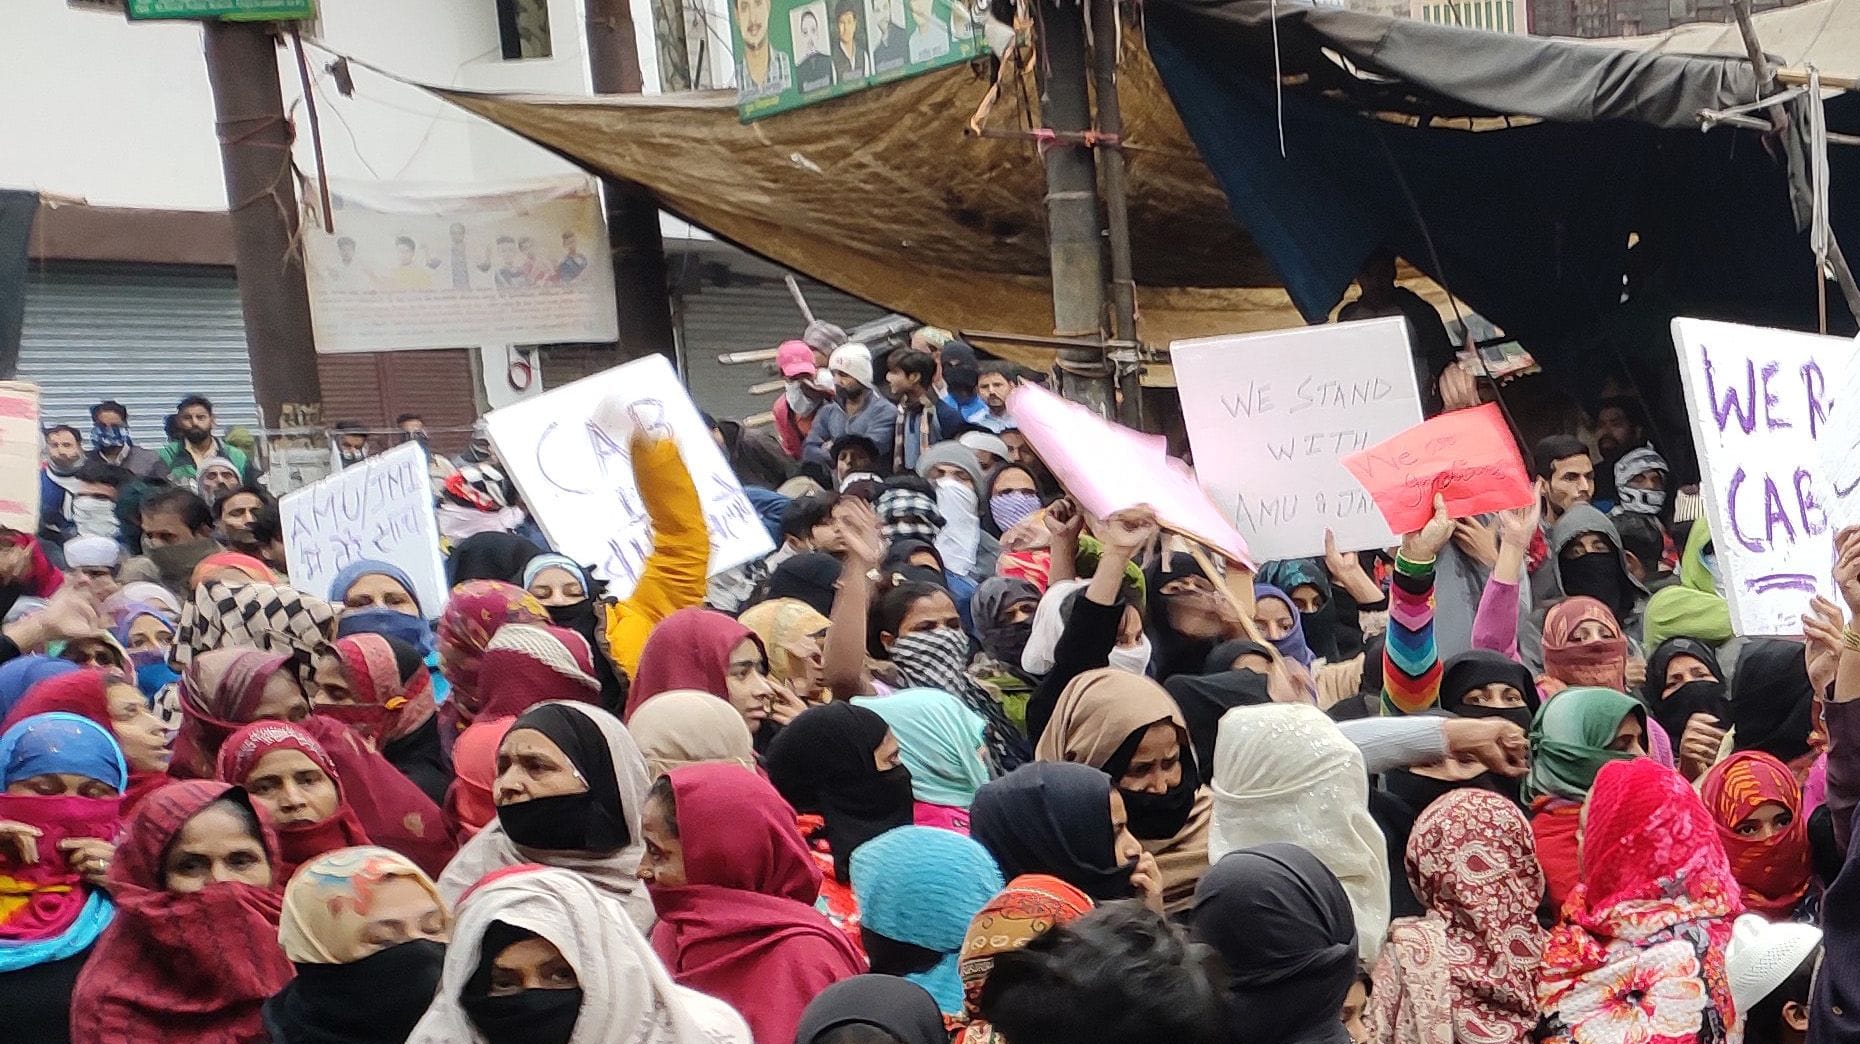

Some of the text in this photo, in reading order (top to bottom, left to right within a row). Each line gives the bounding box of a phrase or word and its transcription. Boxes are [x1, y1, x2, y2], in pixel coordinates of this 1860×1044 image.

[1221, 375, 1393, 419] WE STAND
[1699, 343, 1793, 436] WE
[1266, 431, 1369, 463] WITH
[1235, 492, 1299, 534] AMU
[1727, 466, 1828, 553] CAB
